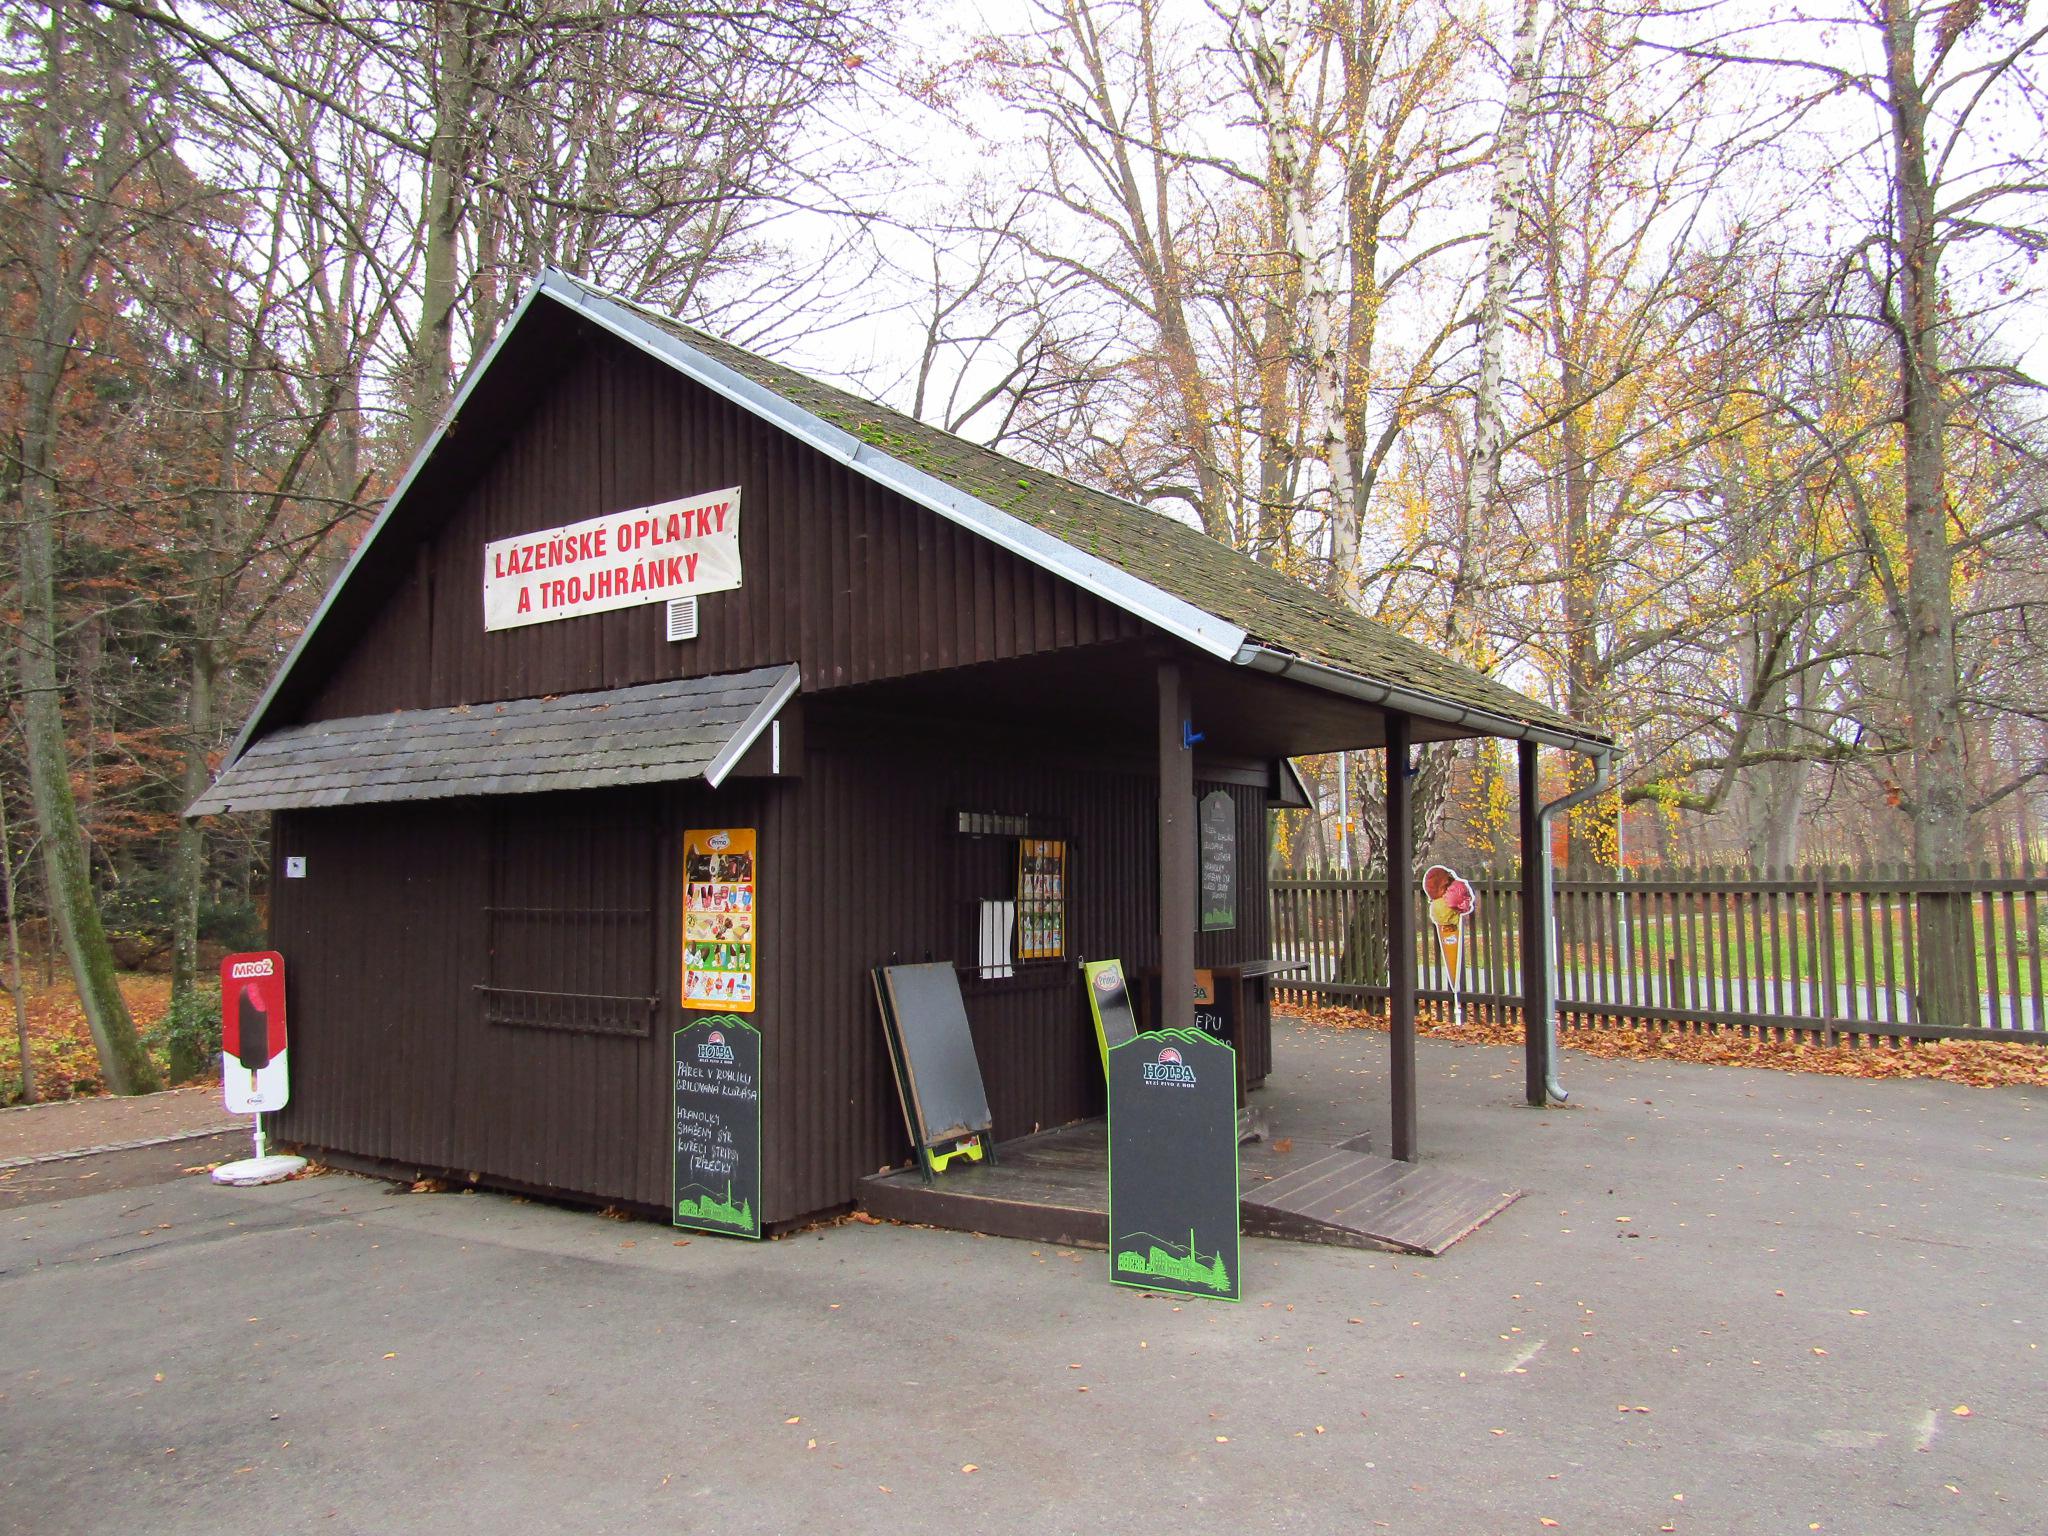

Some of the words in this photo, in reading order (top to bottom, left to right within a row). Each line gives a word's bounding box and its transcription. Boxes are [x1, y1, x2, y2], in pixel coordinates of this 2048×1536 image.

[495, 523, 607, 578] LÁZEŇSKÉ
[617, 502, 729, 553] OPLATKY
[517, 586, 531, 614] A
[540, 553, 699, 609] TROJHRÁNKY
[233, 959, 273, 977] MROŽ
[1194, 1011, 1221, 1030] EPU
[698, 1044, 734, 1060] HOLBA
[676, 1061, 704, 1078] PÁREK
[707, 1069, 714, 1079] V
[1143, 1063, 1196, 1082] HOLBA
[677, 1106, 720, 1125] HRANOLKY
